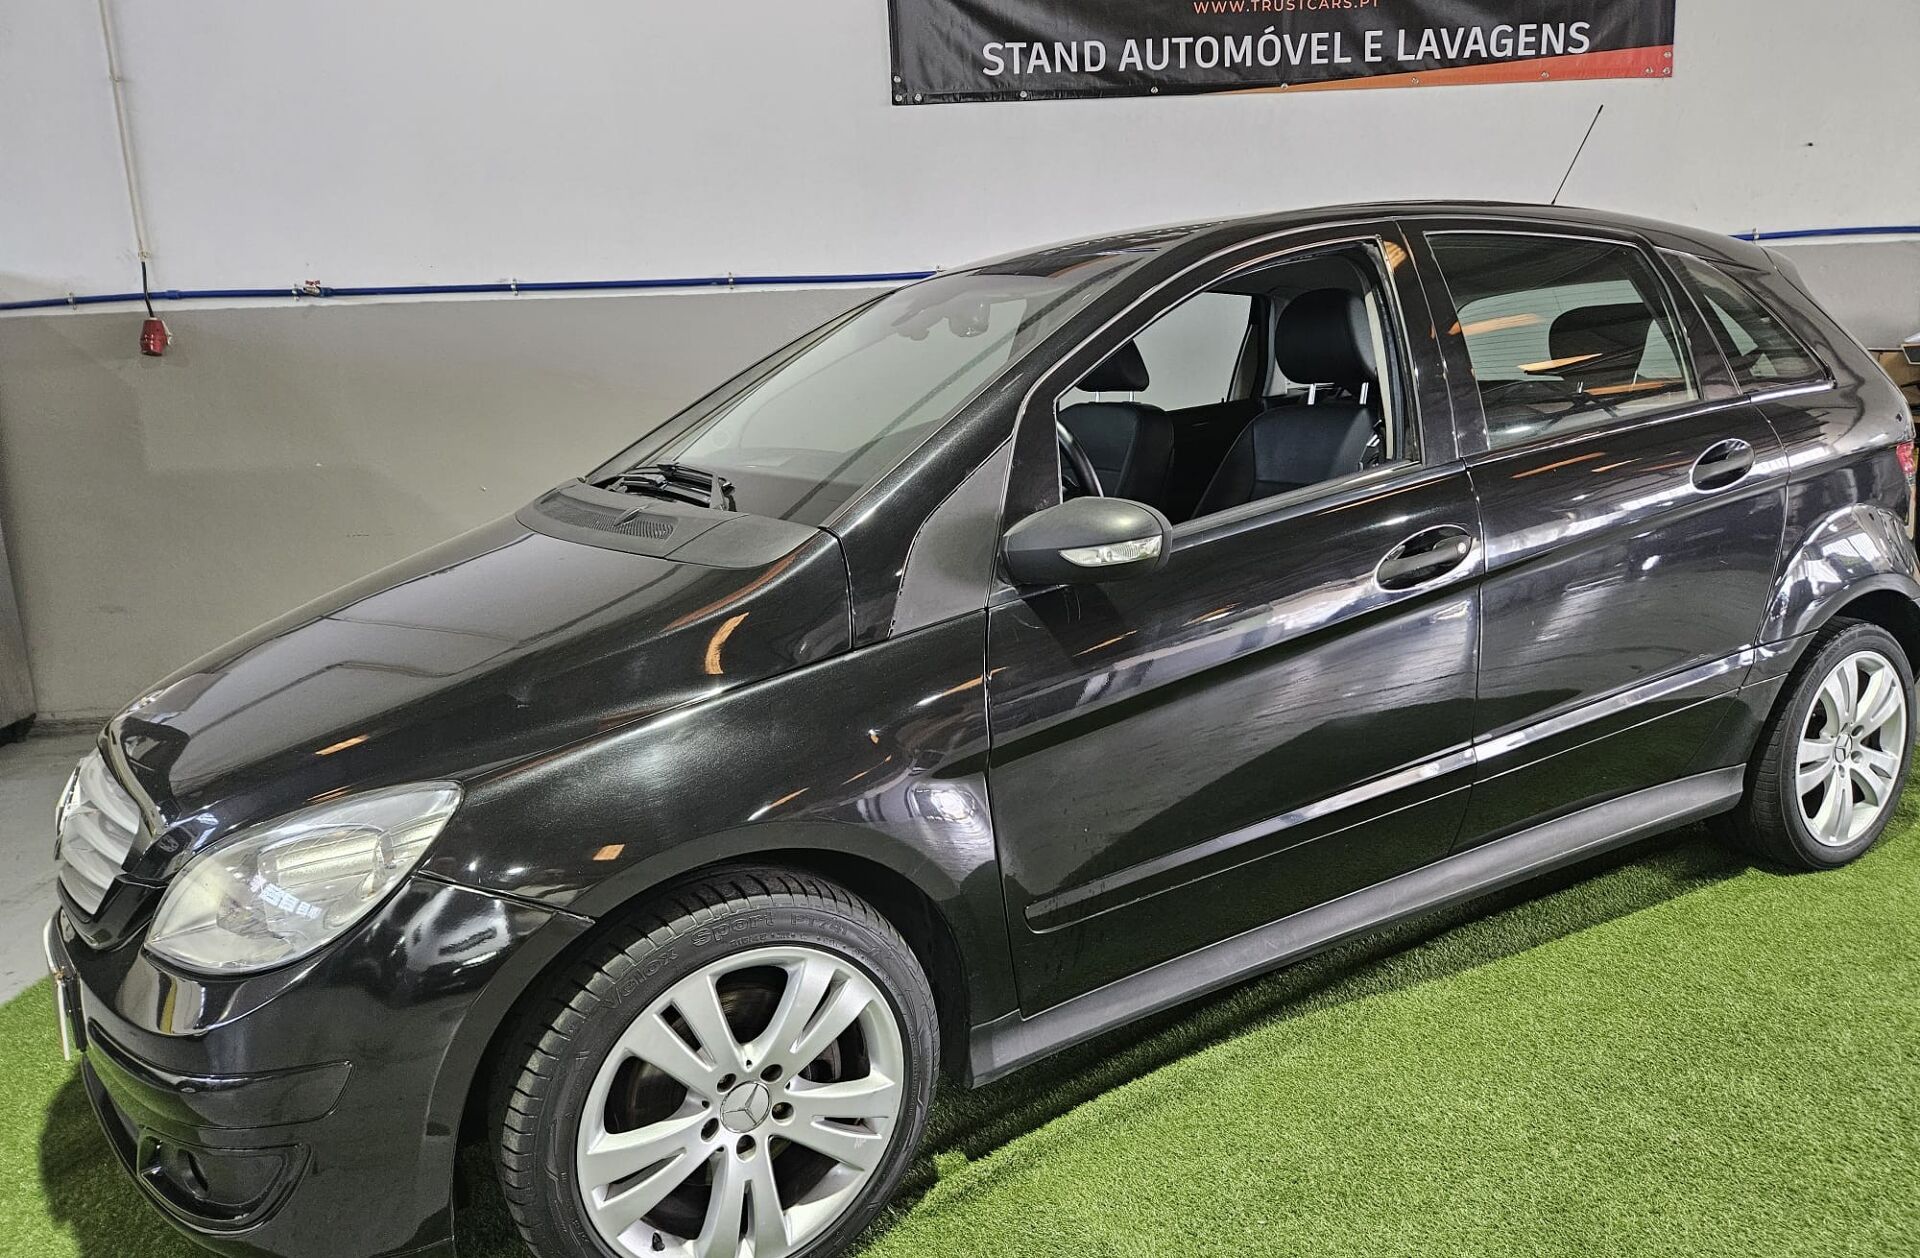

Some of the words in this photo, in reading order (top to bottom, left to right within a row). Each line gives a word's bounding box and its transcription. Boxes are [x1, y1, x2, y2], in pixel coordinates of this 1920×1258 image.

[982, 40, 1107, 76] STAND
[1118, 25, 1352, 72] AUTOMÓVEL
[1364, 30, 1384, 62] E
[1397, 21, 1591, 61] LAVAGENS
